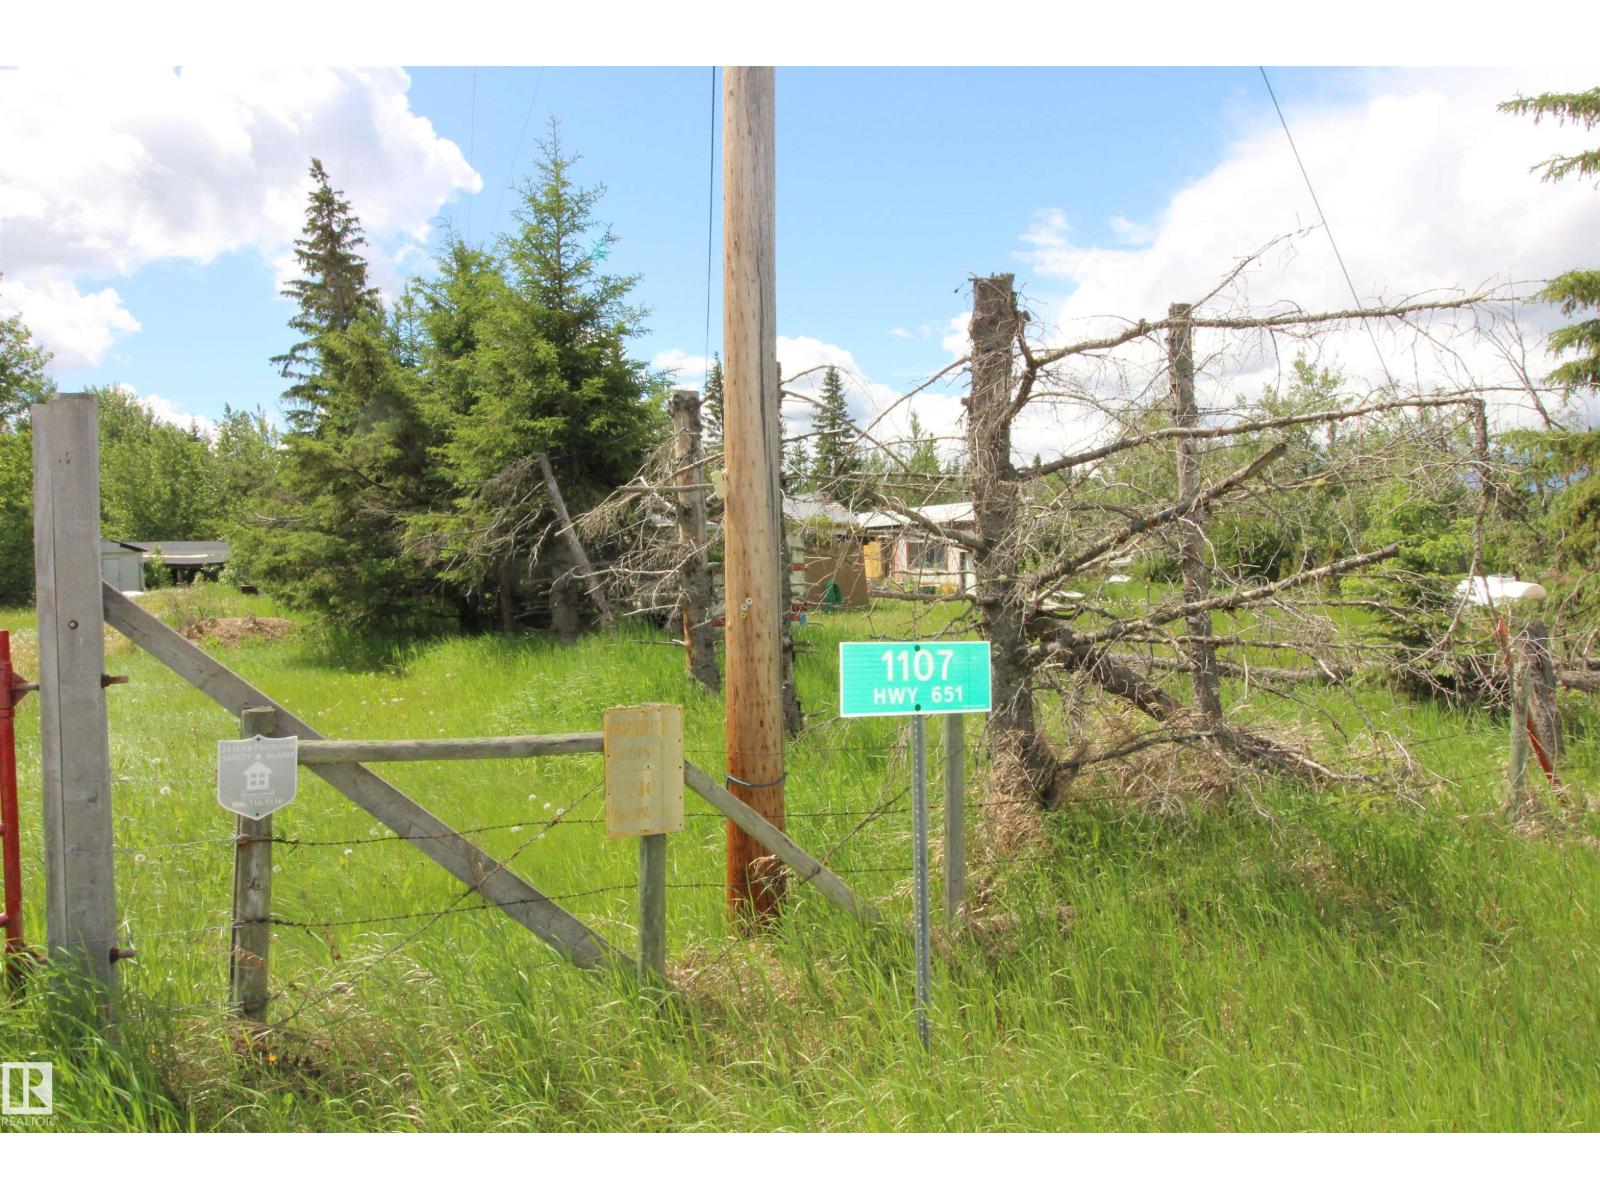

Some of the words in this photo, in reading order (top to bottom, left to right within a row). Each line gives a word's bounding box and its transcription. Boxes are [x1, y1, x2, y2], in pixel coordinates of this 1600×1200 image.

[881, 649, 954, 682] 1107
[873, 687, 918, 705] HWY
[931, 685, 963, 703] 651
